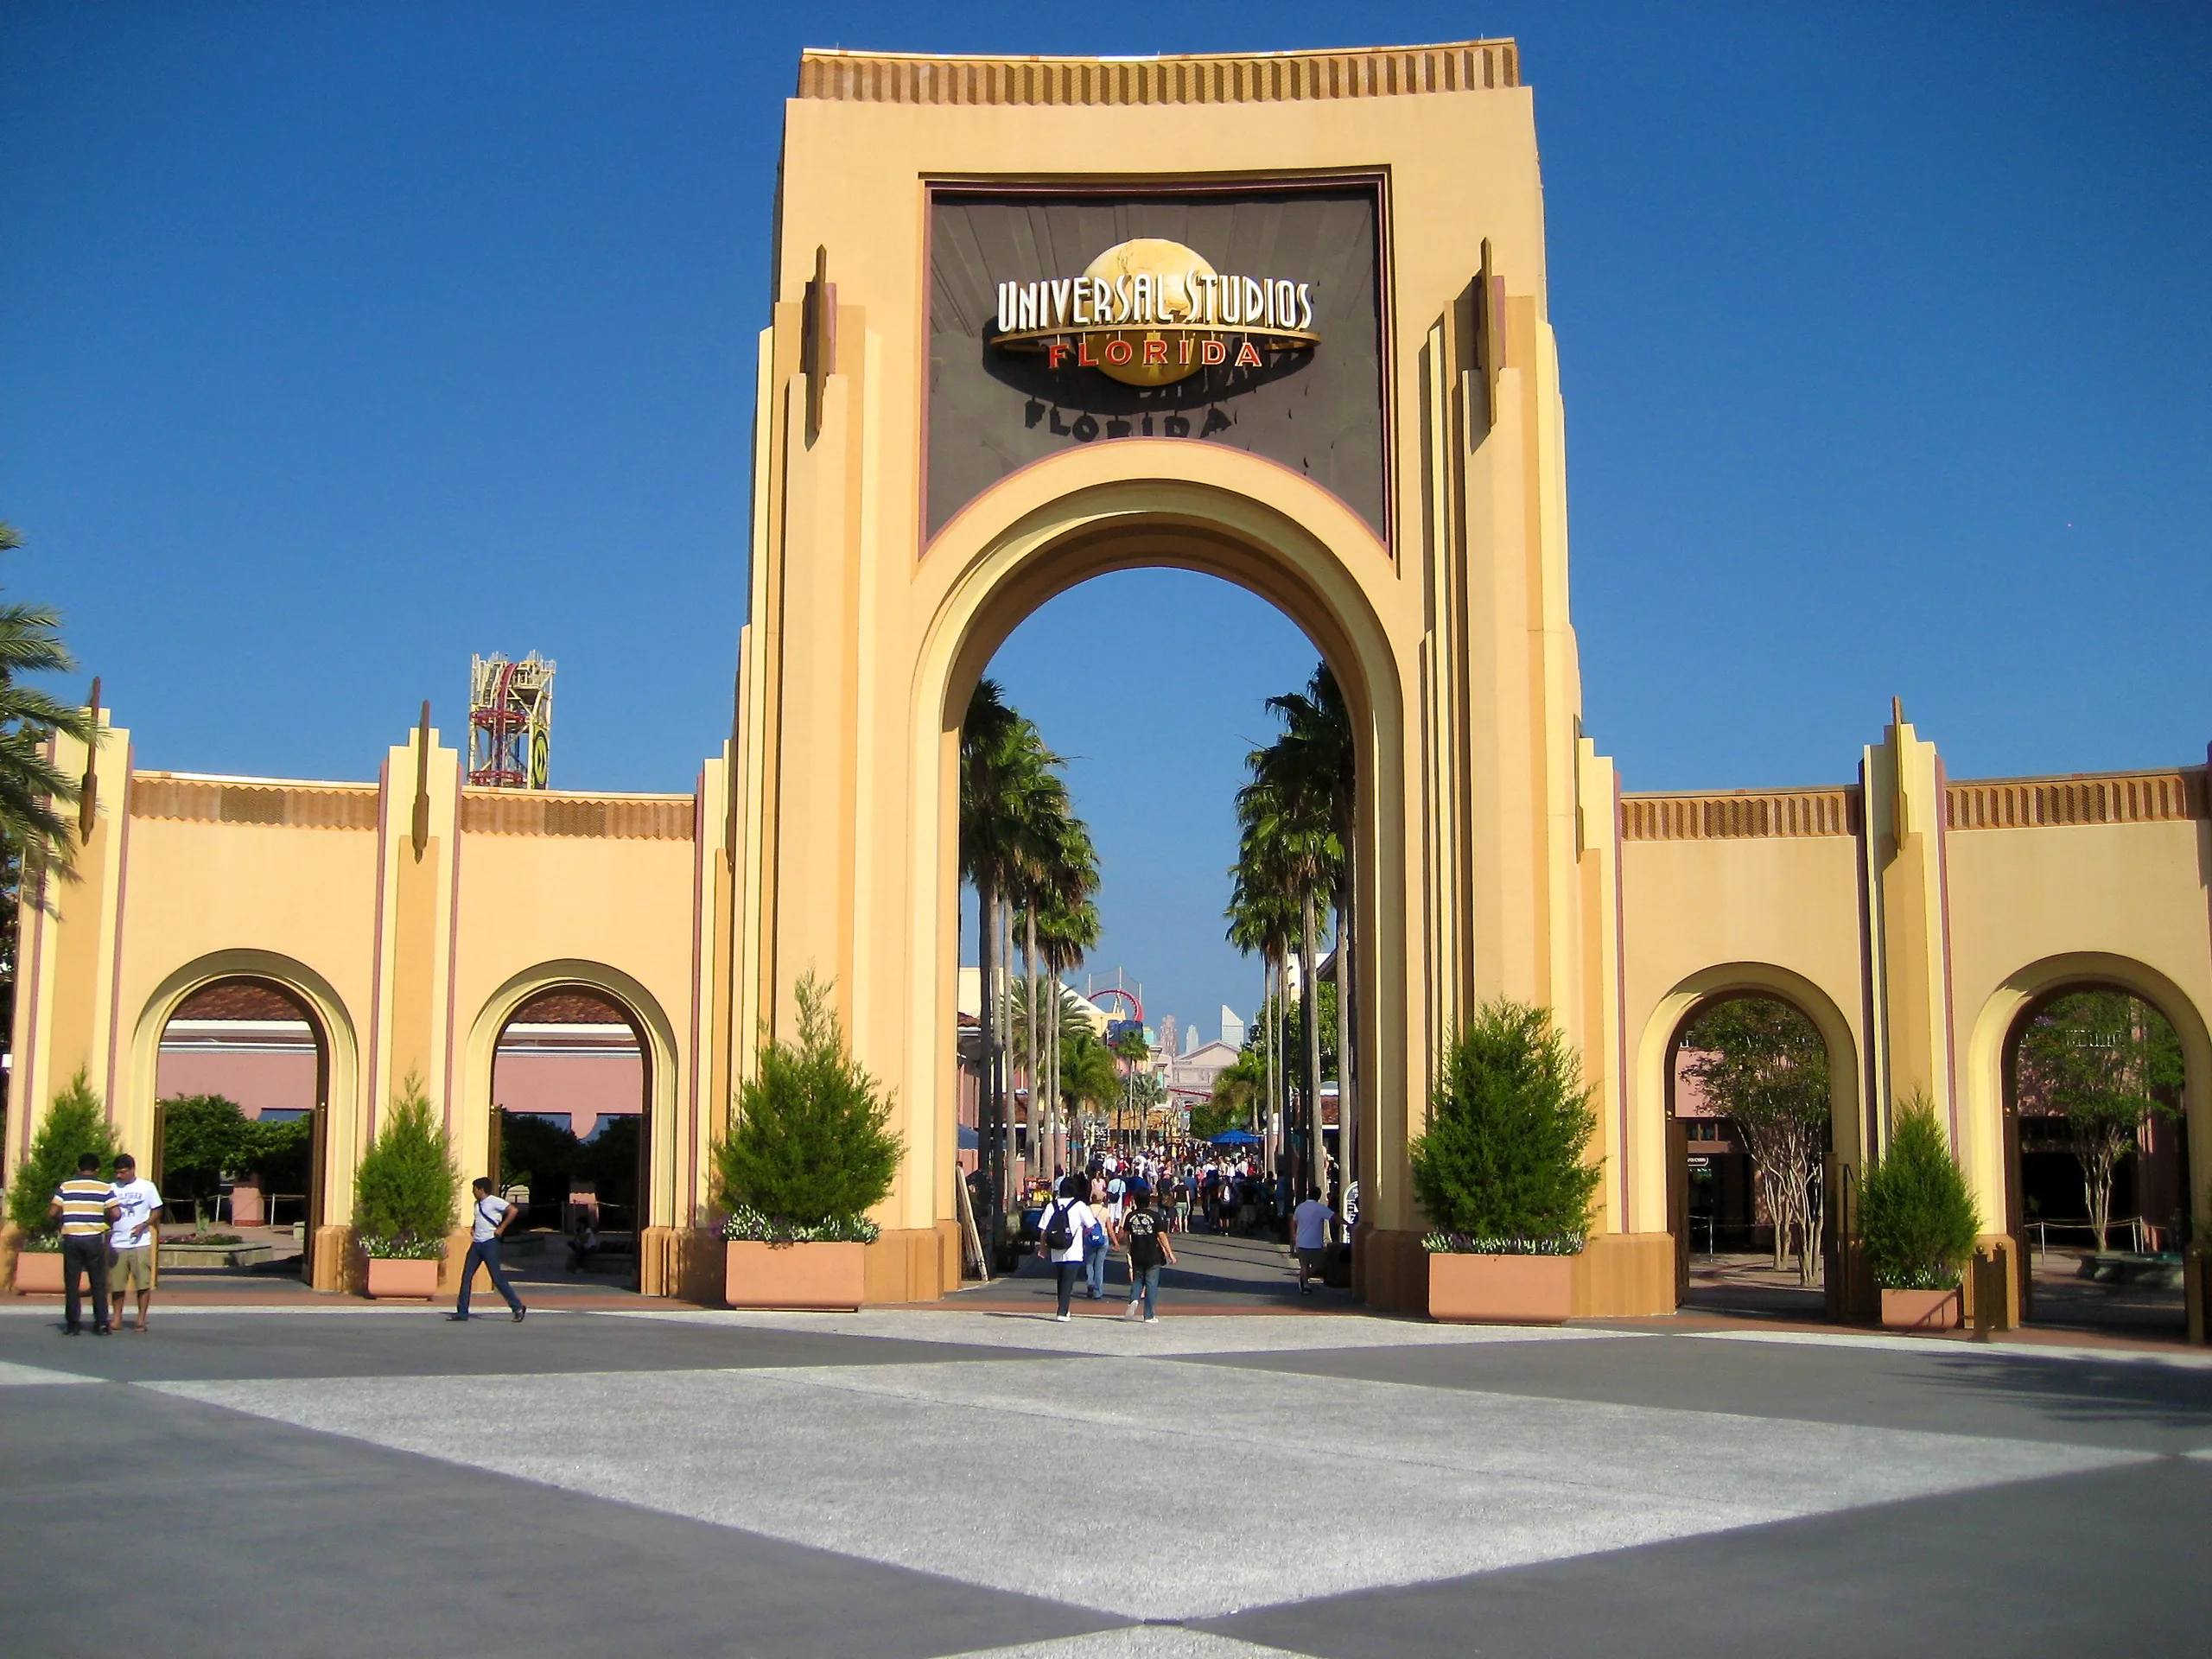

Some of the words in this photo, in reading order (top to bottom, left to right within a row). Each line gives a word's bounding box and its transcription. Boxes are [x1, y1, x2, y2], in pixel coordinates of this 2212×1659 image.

[998, 273, 1174, 333] UNIVERSAL
[1182, 269, 1313, 331] STUDIOS
[1048, 339, 1262, 369] FLORIDA
